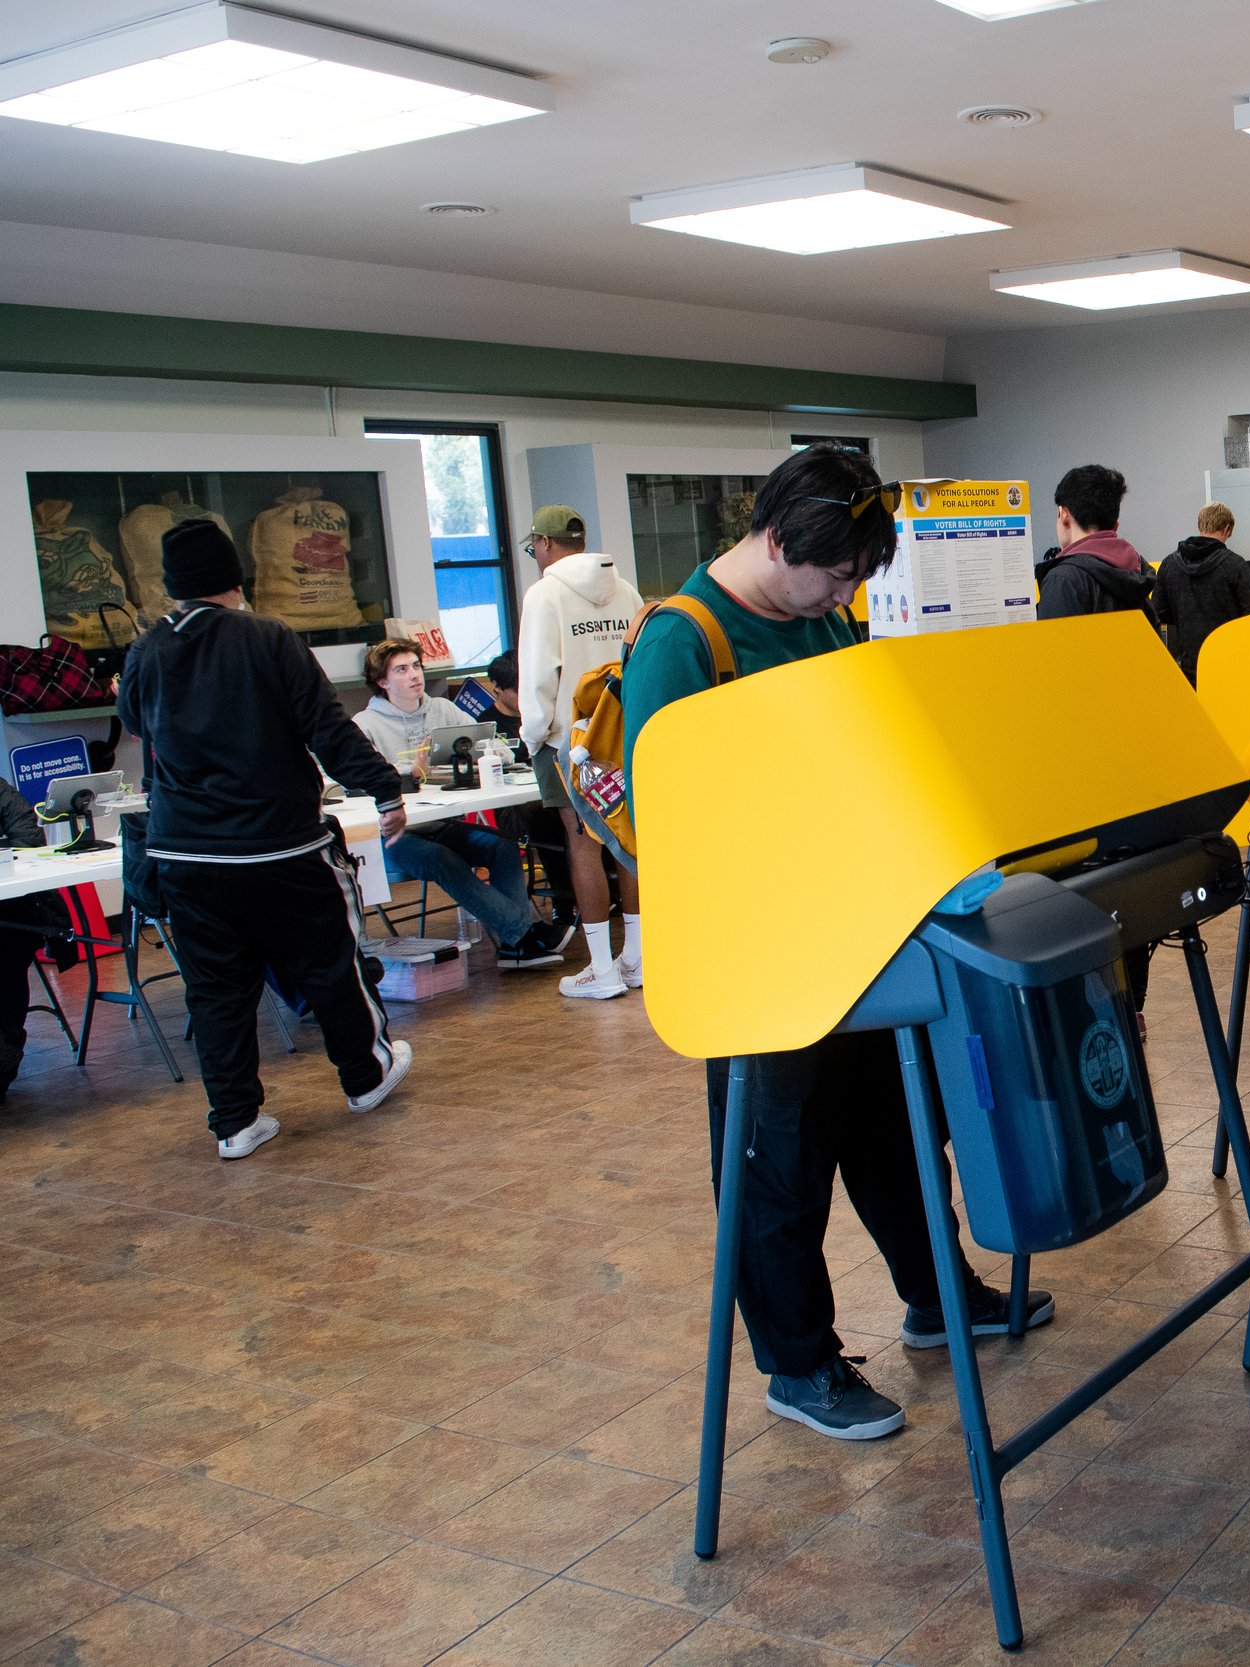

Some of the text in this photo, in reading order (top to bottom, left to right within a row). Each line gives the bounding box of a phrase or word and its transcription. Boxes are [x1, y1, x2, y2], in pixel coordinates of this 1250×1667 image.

[935, 519, 1006, 529] VOTER BILL OF RIGHTS
[19, 774, 24, 782] It
[26, 773, 32, 781] is
[44, 762, 85, 776] accessibility.
[21, 755, 81, 772] Do not move cone.
